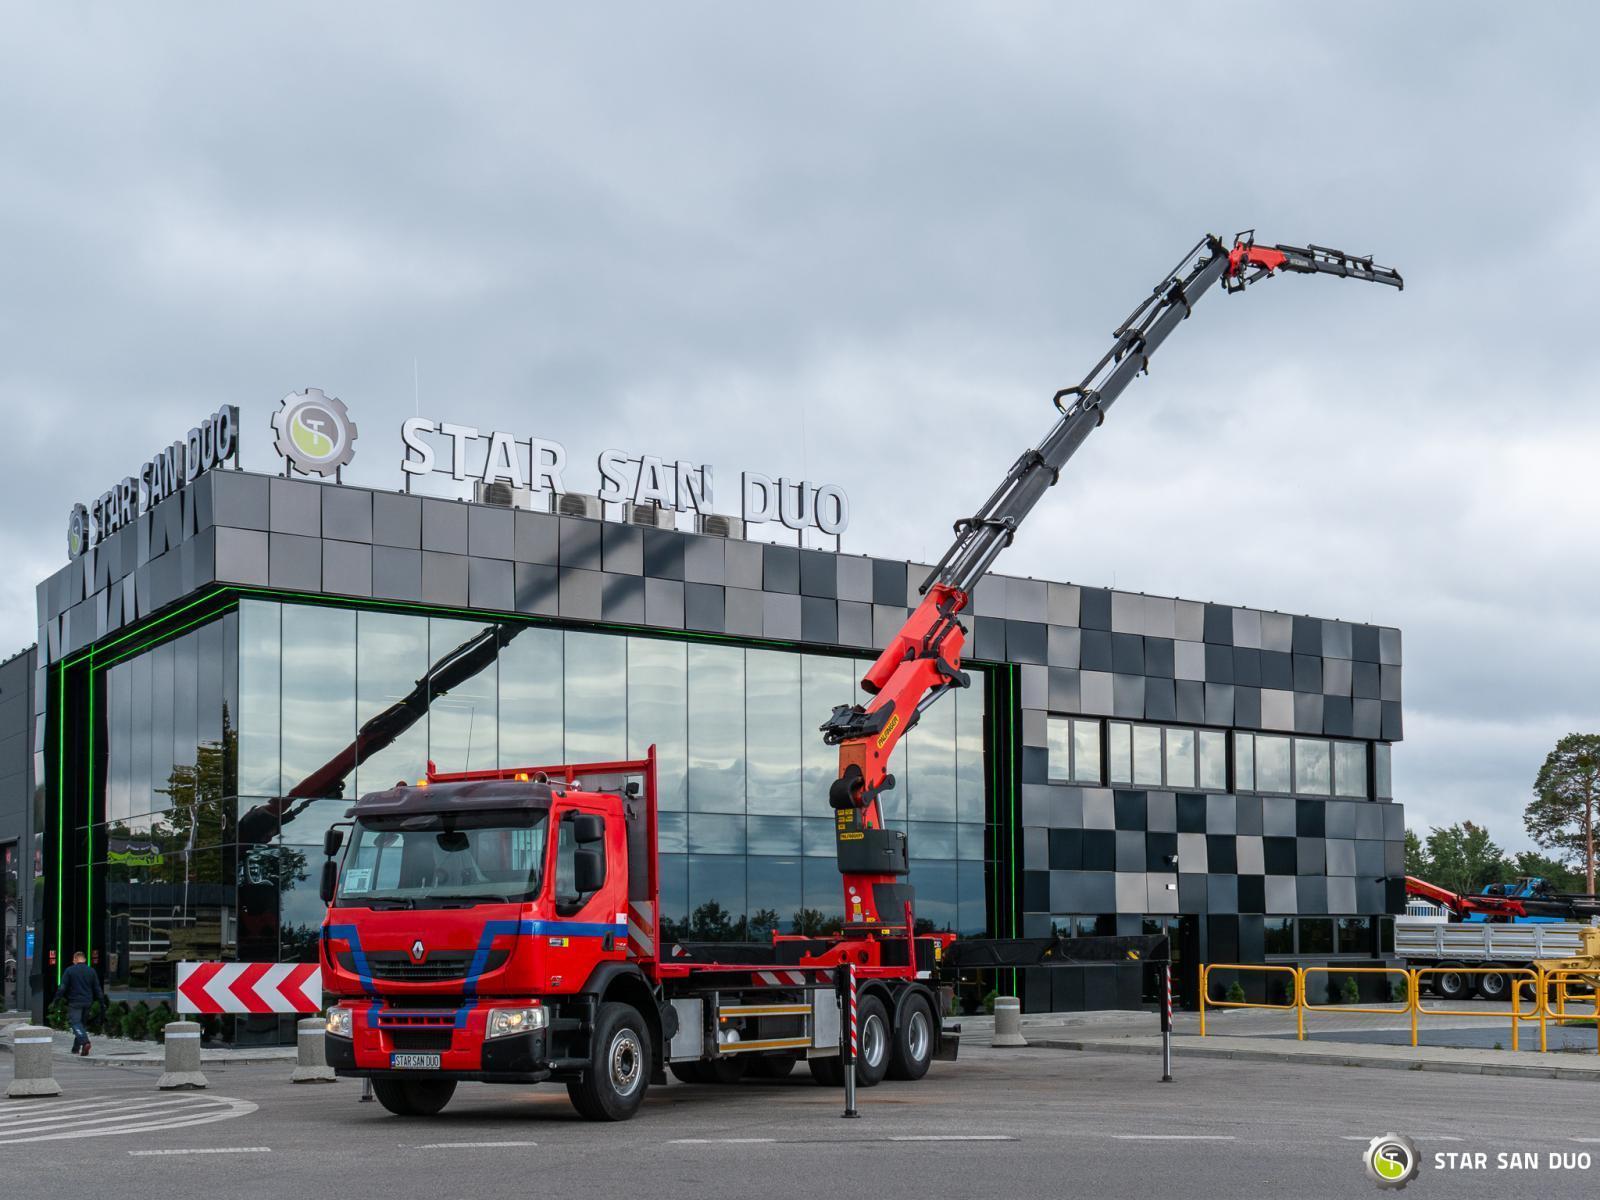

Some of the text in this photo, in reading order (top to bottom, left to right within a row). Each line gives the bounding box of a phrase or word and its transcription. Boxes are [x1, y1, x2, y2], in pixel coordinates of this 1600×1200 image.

[90, 404, 235, 545] STAR SAN DUO
[401, 417, 850, 535] STAR SAN DUO
[395, 1055, 439, 1067] STAR SAN DUO
